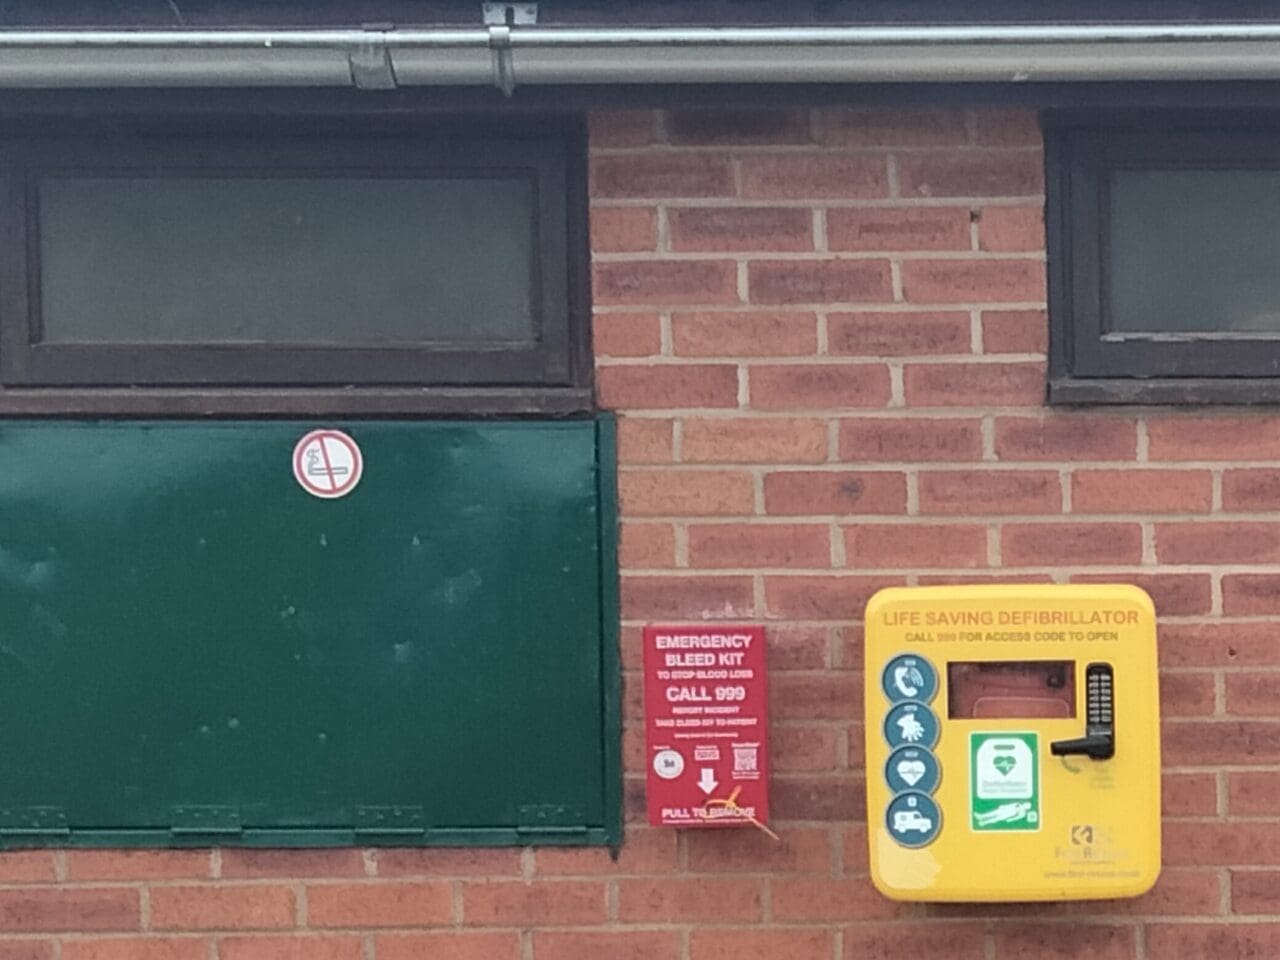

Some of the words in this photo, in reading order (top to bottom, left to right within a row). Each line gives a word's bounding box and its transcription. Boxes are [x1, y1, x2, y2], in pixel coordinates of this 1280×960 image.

[883, 611, 920, 626] LIFE
[926, 611, 993, 626] SAVING
[998, 610, 1139, 625] DEFIBRILLATOR
[656, 635, 752, 649] EMERGENCY
[905, 632, 934, 642] CALL
[960, 632, 983, 642] FOR
[985, 631, 1031, 642] ACCESS
[1034, 631, 1066, 641] CODE
[1069, 631, 1084, 641] TO
[1087, 631, 1119, 641] OPEN
[665, 653, 715, 667] BLEED
[719, 652, 745, 666] KIT
[657, 671, 670, 679] TO
[671, 670, 695, 679] STOP
[697, 670, 728, 679] BLOOD
[729, 669, 753, 679] LOSS
[666, 686, 711, 702] CALL
[715, 685, 746, 701] 999
[662, 808, 691, 818] PULL
[692, 808, 707, 818] TO
